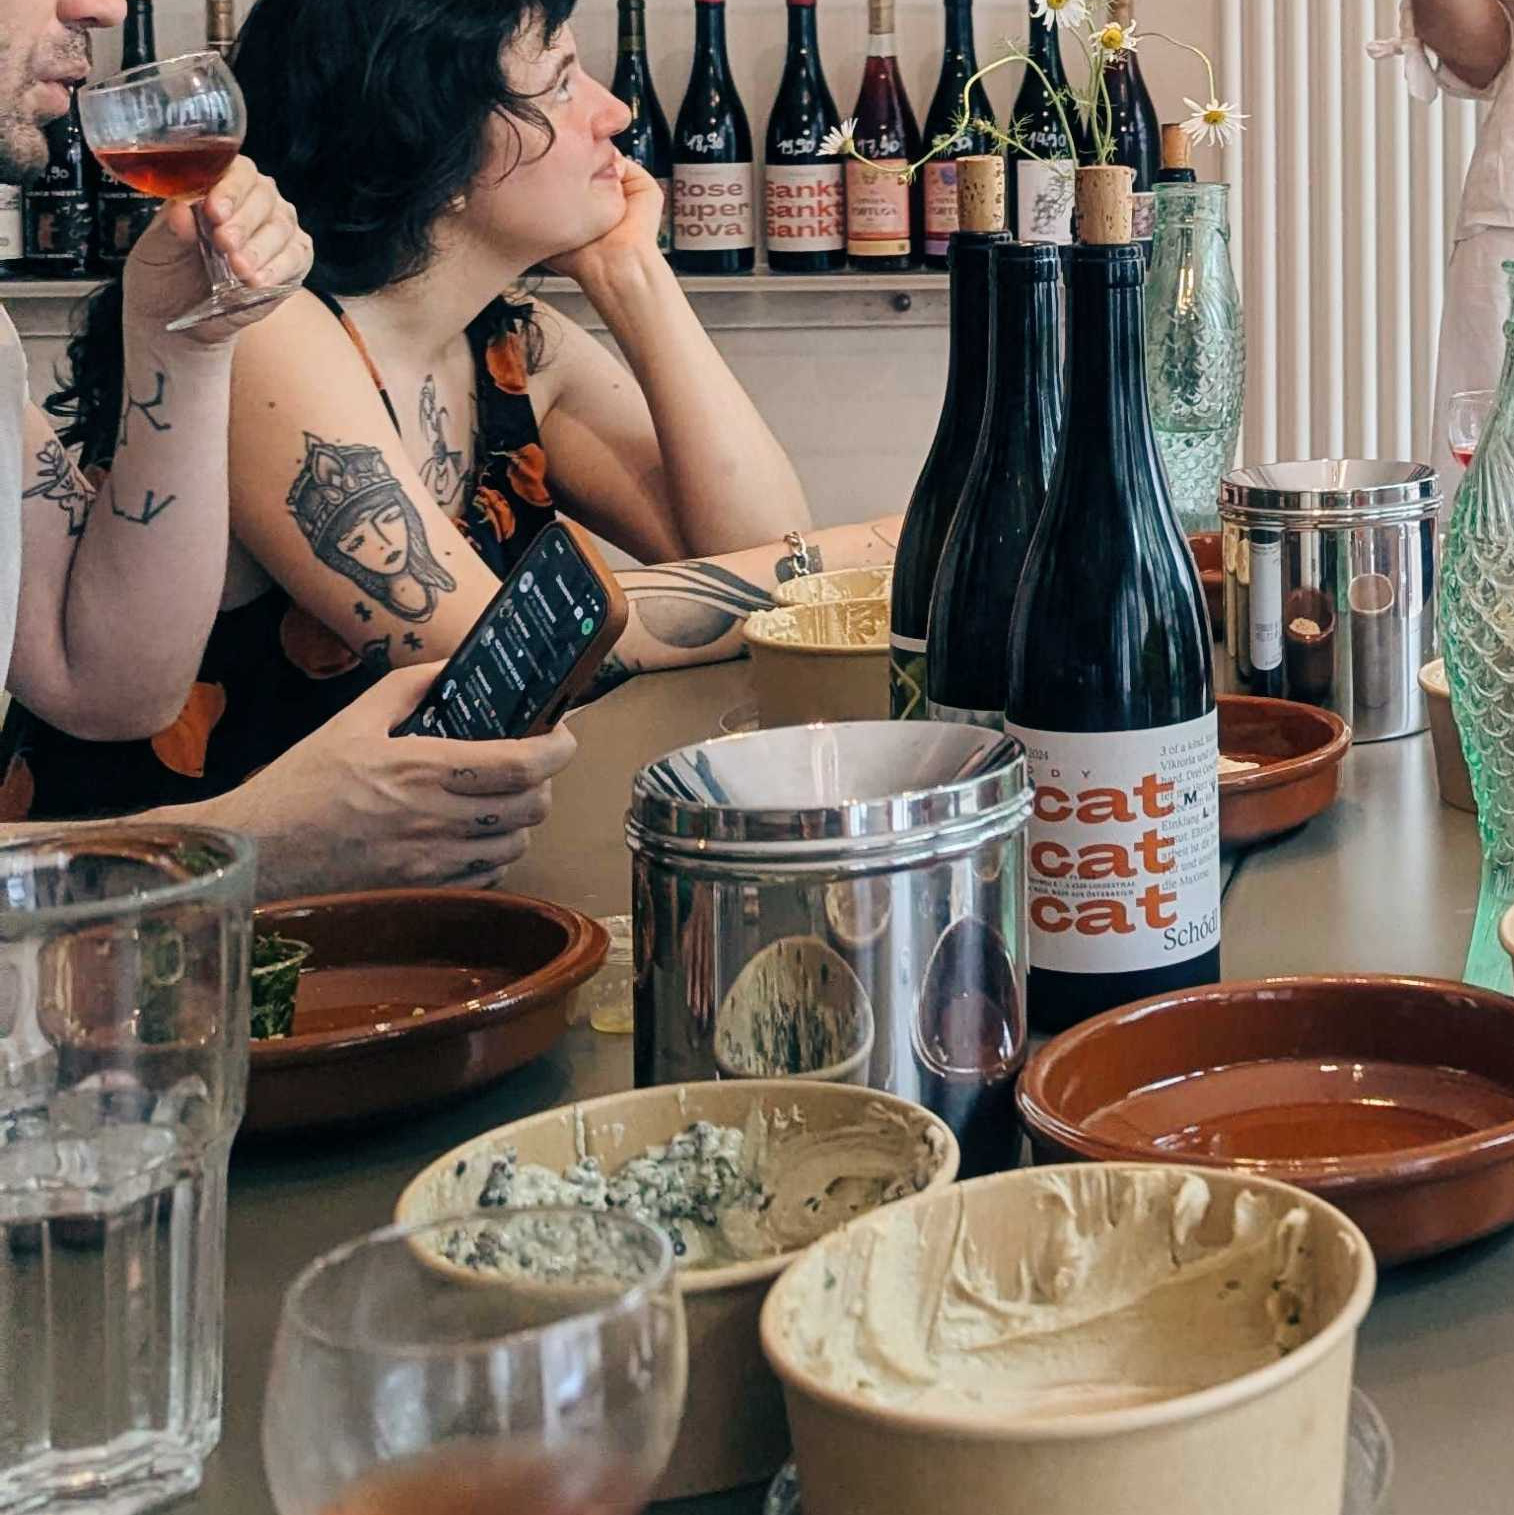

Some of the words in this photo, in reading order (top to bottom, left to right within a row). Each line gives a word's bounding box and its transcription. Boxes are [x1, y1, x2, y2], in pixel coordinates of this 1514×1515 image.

[674, 179, 743, 197] Rose
[1033, 773, 1176, 824] cat
[1030, 829, 1176, 879] cat
[1030, 884, 1178, 936] cat
